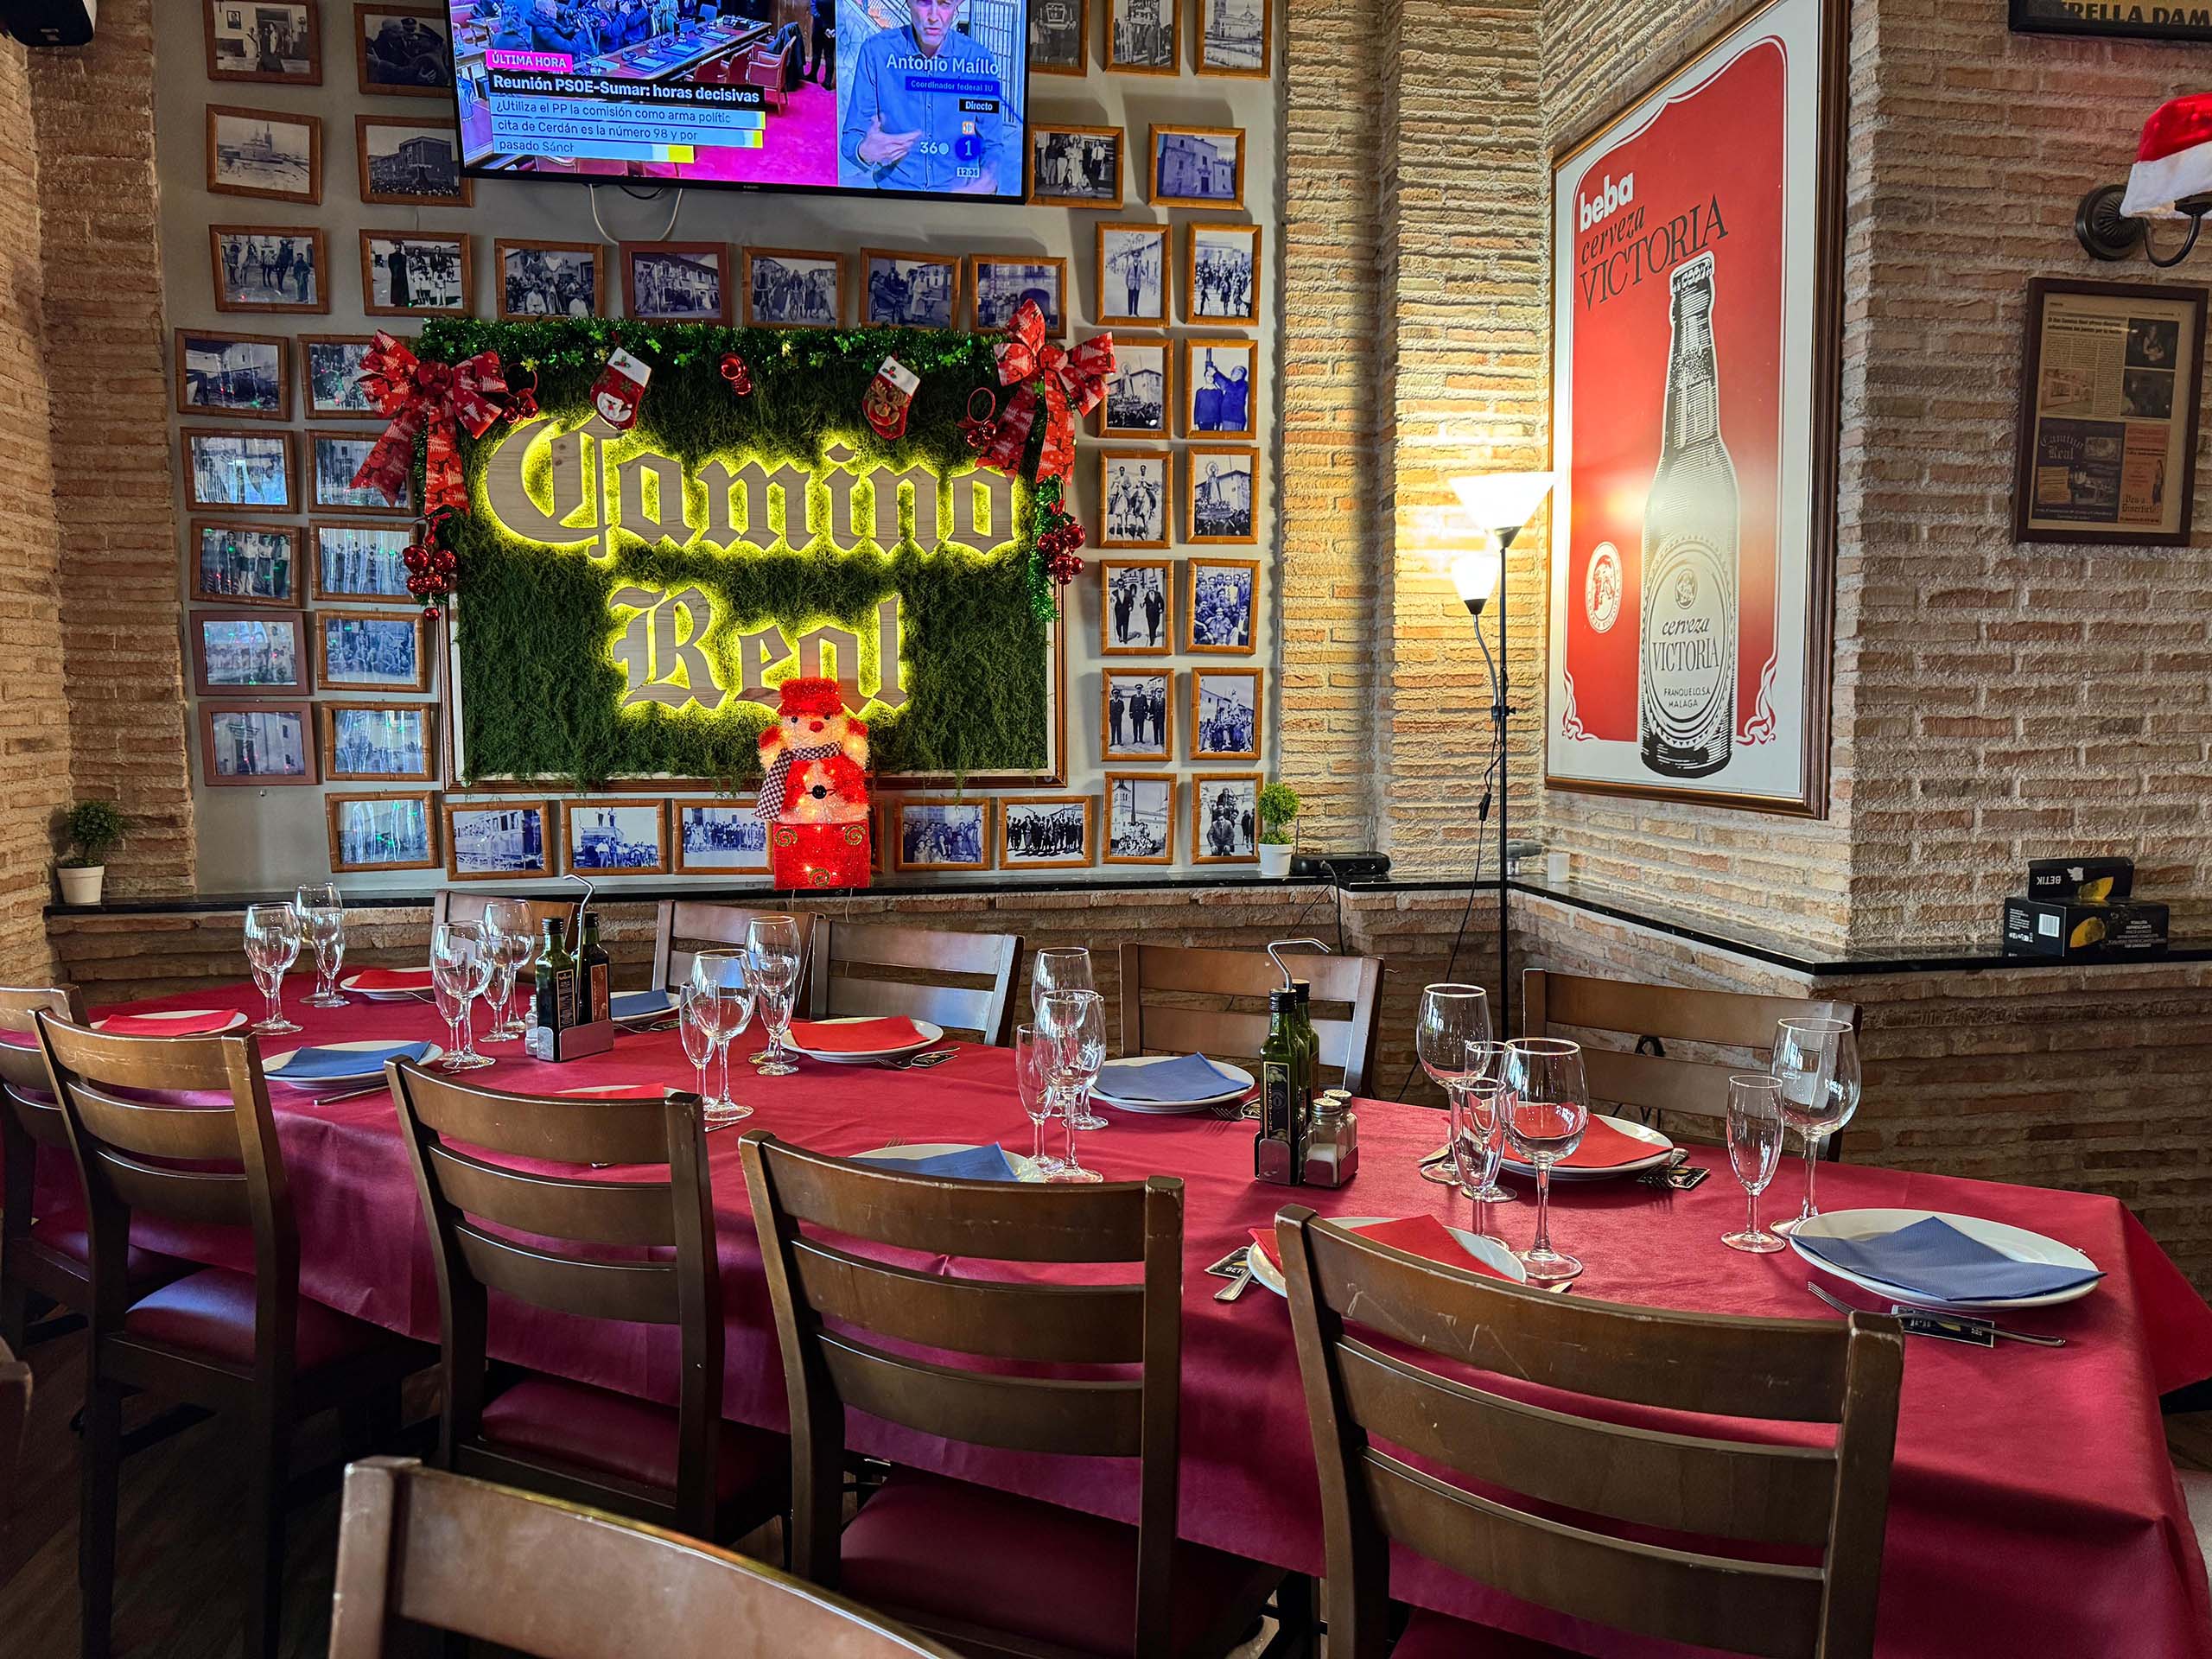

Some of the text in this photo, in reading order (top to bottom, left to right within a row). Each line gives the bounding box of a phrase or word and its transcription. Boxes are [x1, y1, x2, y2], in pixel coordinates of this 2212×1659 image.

[492, 51, 567, 68] ÚLTIMA HORA
[886, 54, 1000, 75] Antonio Maíllo
[493, 74, 760, 103] Reunión PSOE-Sumar: horas decisivas
[911, 79, 955, 90] Coordinador
[957, 83, 982, 92] federal
[496, 100, 537, 112] ¿Utiliza
[539, 104, 550, 112] el
[552, 104, 568, 113] PP
[570, 105, 580, 115] la
[582, 106, 632, 118] comisión
[635, 110, 665, 119] como
[668, 111, 696, 121] arma
[964, 100, 994, 111] Directo
[498, 121, 697, 141] cita de Cerdán es la número 98 y por
[499, 140, 539, 151] pasado
[1580, 172, 1634, 233] beba
[1581, 205, 1645, 265] cerveza
[1580, 194, 1728, 311] VICTORIA
[486, 413, 1017, 559] Camino
[1662, 618, 1710, 636] cerveza
[608, 586, 907, 714] Real
[1652, 636, 1719, 671] VICTORIA
